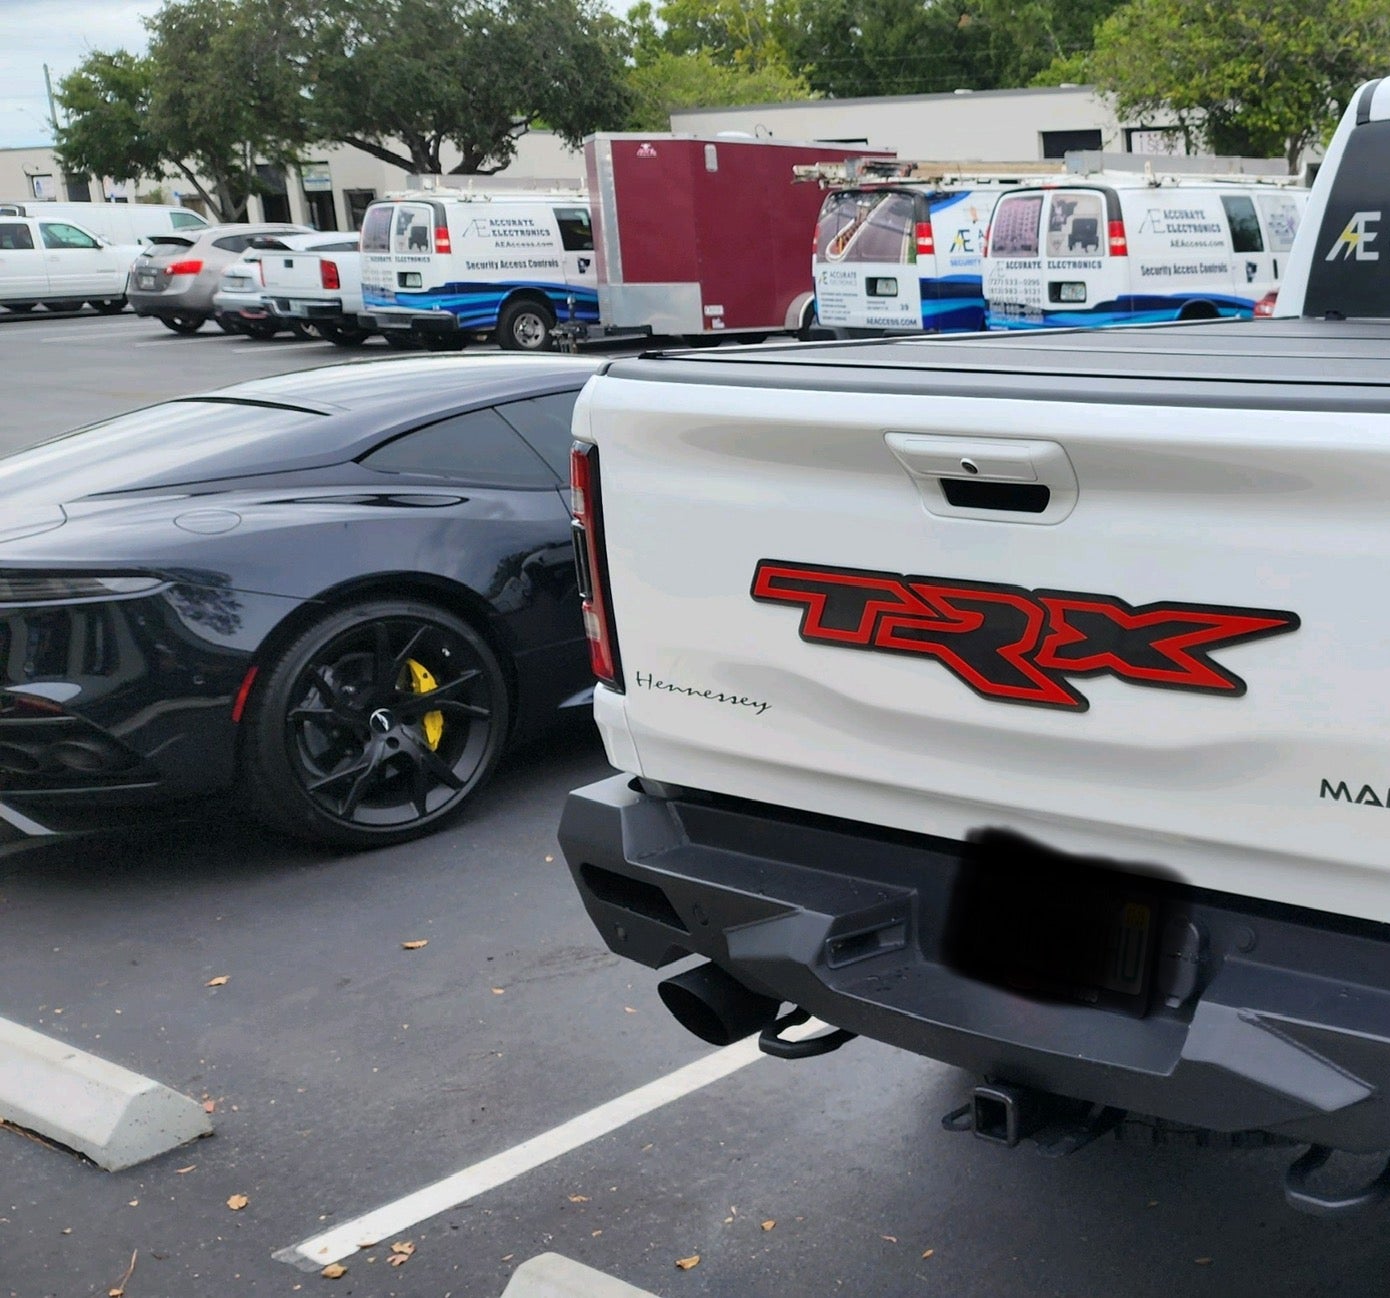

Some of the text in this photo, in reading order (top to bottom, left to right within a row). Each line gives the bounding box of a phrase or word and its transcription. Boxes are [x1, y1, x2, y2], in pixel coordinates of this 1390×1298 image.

[1163, 209, 1206, 220] ACCURATE
[489, 218, 535, 228] ACCURATE
[1167, 223, 1222, 233] ELECTRONICS
[491, 228, 550, 238] ELECTRONICS
[1170, 239, 1225, 248] AEAccess.com
[465, 258, 560, 270] Security Access Controls
[1005, 260, 1103, 270] ACCURATE ELECTRONICS
[1140, 261, 1228, 276] Security Access Controls
[749, 558, 1301, 713] TRX
[636, 671, 772, 716] Hennessey
